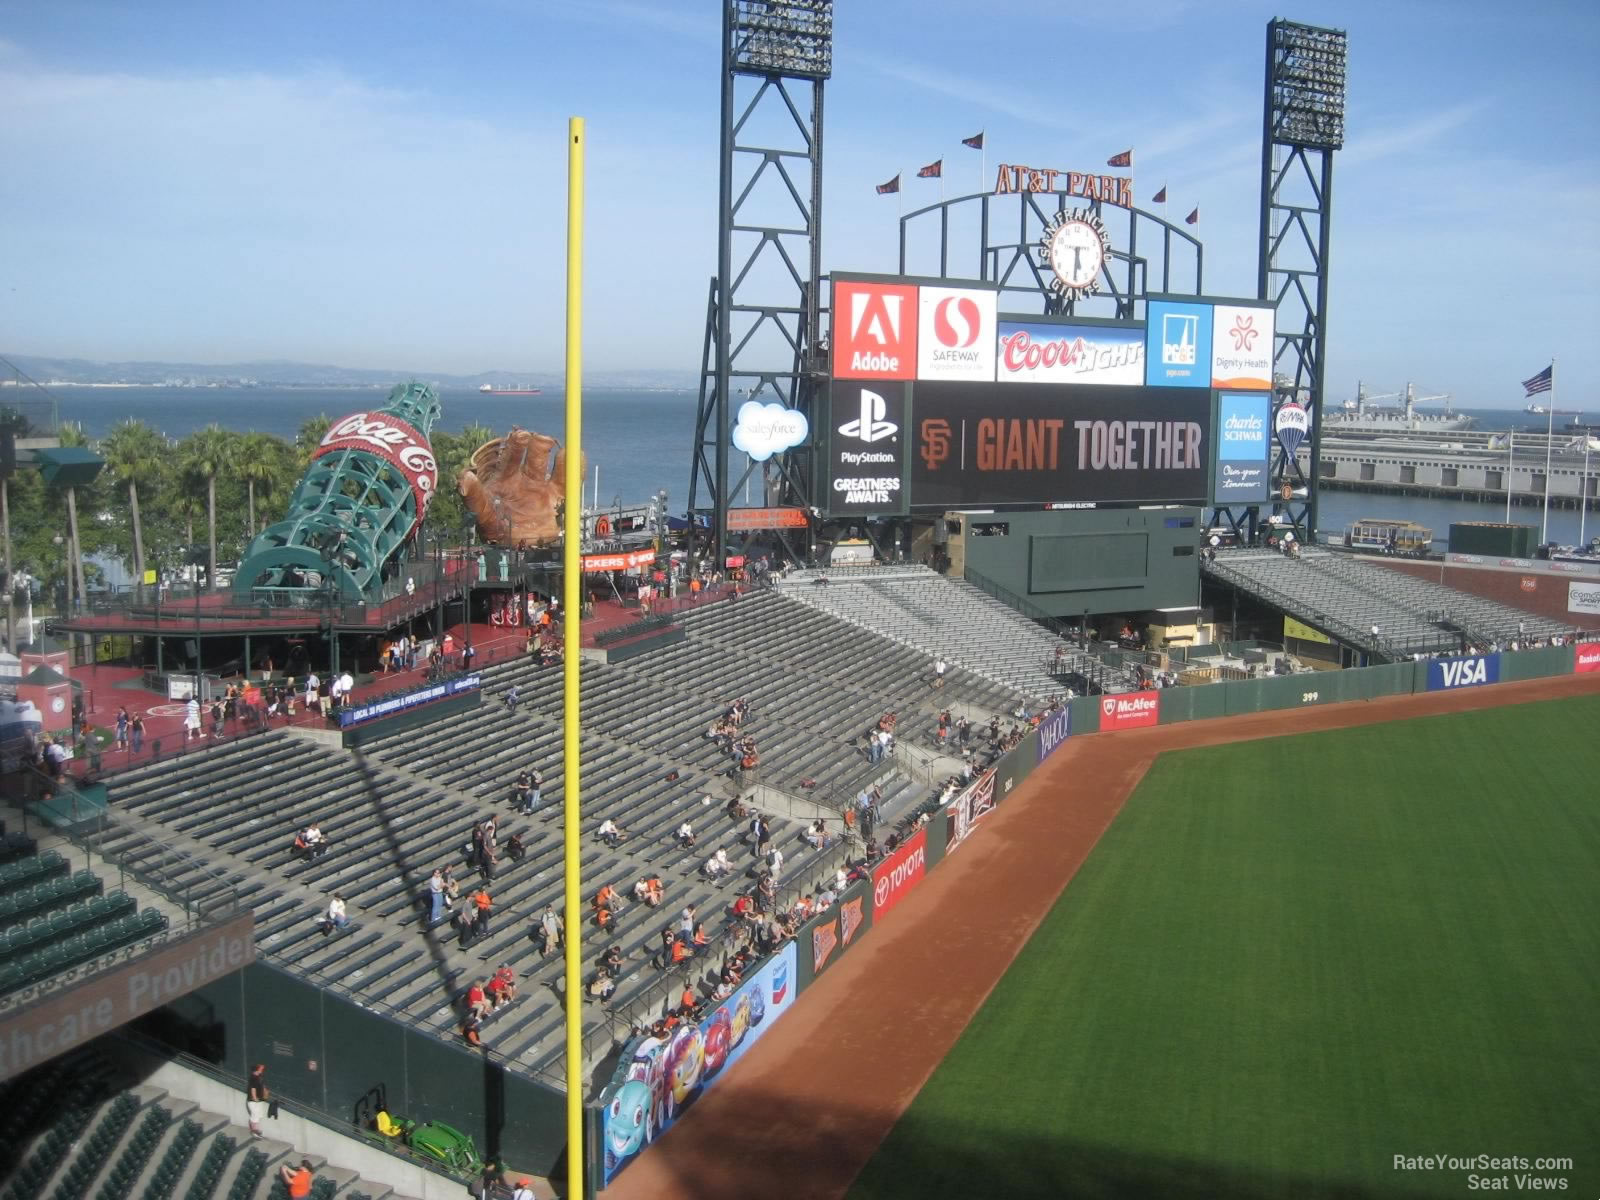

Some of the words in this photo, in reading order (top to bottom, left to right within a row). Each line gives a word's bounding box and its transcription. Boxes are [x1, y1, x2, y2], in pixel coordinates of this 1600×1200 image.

[995, 164, 1058, 195] AT&T
[1067, 172, 1133, 208] PARK
[1040, 224, 1057, 258] SAN
[1055, 207, 1114, 262] FRANCISCO
[1050, 278, 1101, 301] GIANTS
[851, 351, 899, 372] Adobe
[933, 350, 980, 361] SAFEWAY
[1002, 331, 1085, 372] Coors
[1216, 357, 1243, 370] Dignity
[1244, 359, 1269, 369] Health
[746, 421, 796, 440] salesforce
[1225, 413, 1262, 430] charles
[976, 418, 1064, 471] GIANT
[1074, 420, 1202, 471] TOGETHER
[1224, 431, 1263, 441] SCHWAB
[833, 478, 900, 491] GREATNESS
[582, 557, 625, 569] CKERS
[1439, 658, 1487, 686] VISA
[1117, 698, 1156, 712] McAfee
[1302, 692, 1318, 702] 399
[1040, 706, 1069, 759] YAHOO!
[890, 846, 925, 892] TOYOTA
